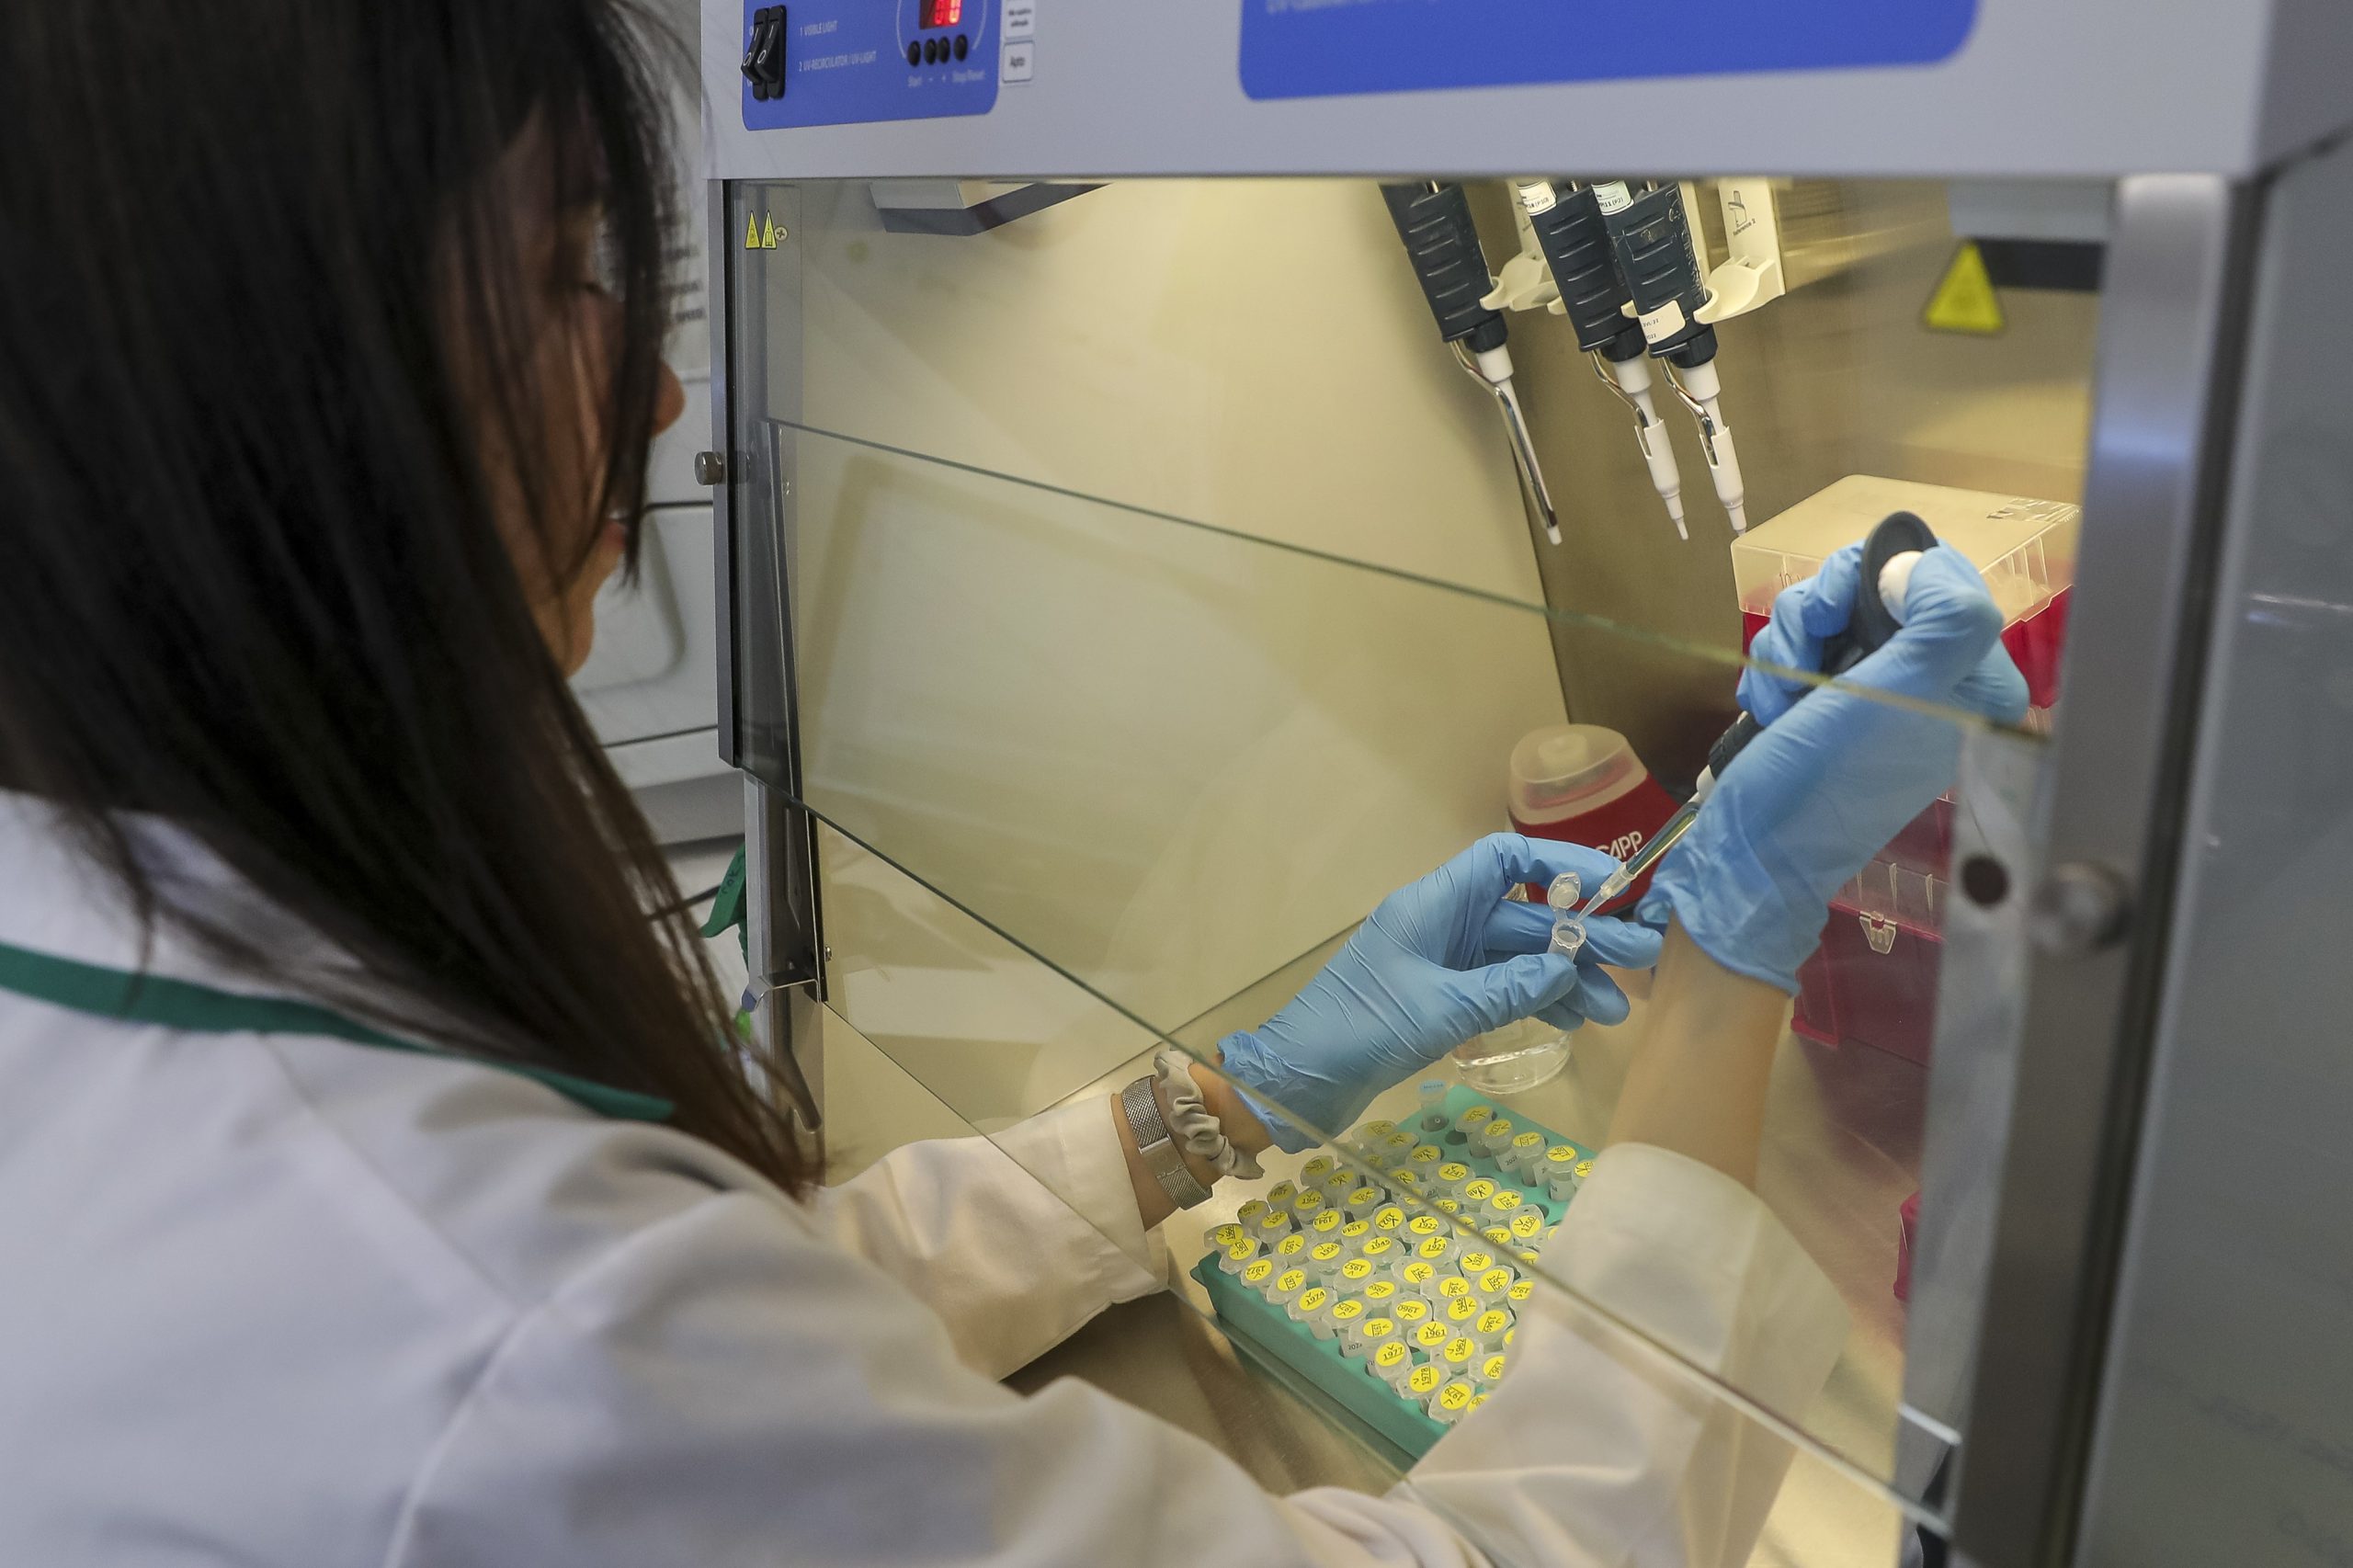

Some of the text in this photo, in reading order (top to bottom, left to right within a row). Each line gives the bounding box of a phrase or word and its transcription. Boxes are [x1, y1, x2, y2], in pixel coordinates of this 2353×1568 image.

[1595, 830, 1643, 860] APP
[1417, 1221, 1438, 1230] 1922
[1521, 1215, 1538, 1233] 1750
[1427, 1243, 1447, 1251] 1923
[1246, 1265, 1266, 1276] 1972
[1344, 1262, 1365, 1272] 1957
[1488, 1275, 1504, 1290] 1925
[1305, 1290, 1325, 1305] 1974
[1397, 1304, 1419, 1314] 1960
[1425, 1328, 1446, 1339] 1961
[1383, 1346, 1404, 1360] 1977
[1455, 1337, 1466, 1357] 1962
[1420, 1367, 1431, 1386] 1978
[1488, 1360, 1505, 1378] 1963
[1444, 1387, 1464, 1402] 1979
